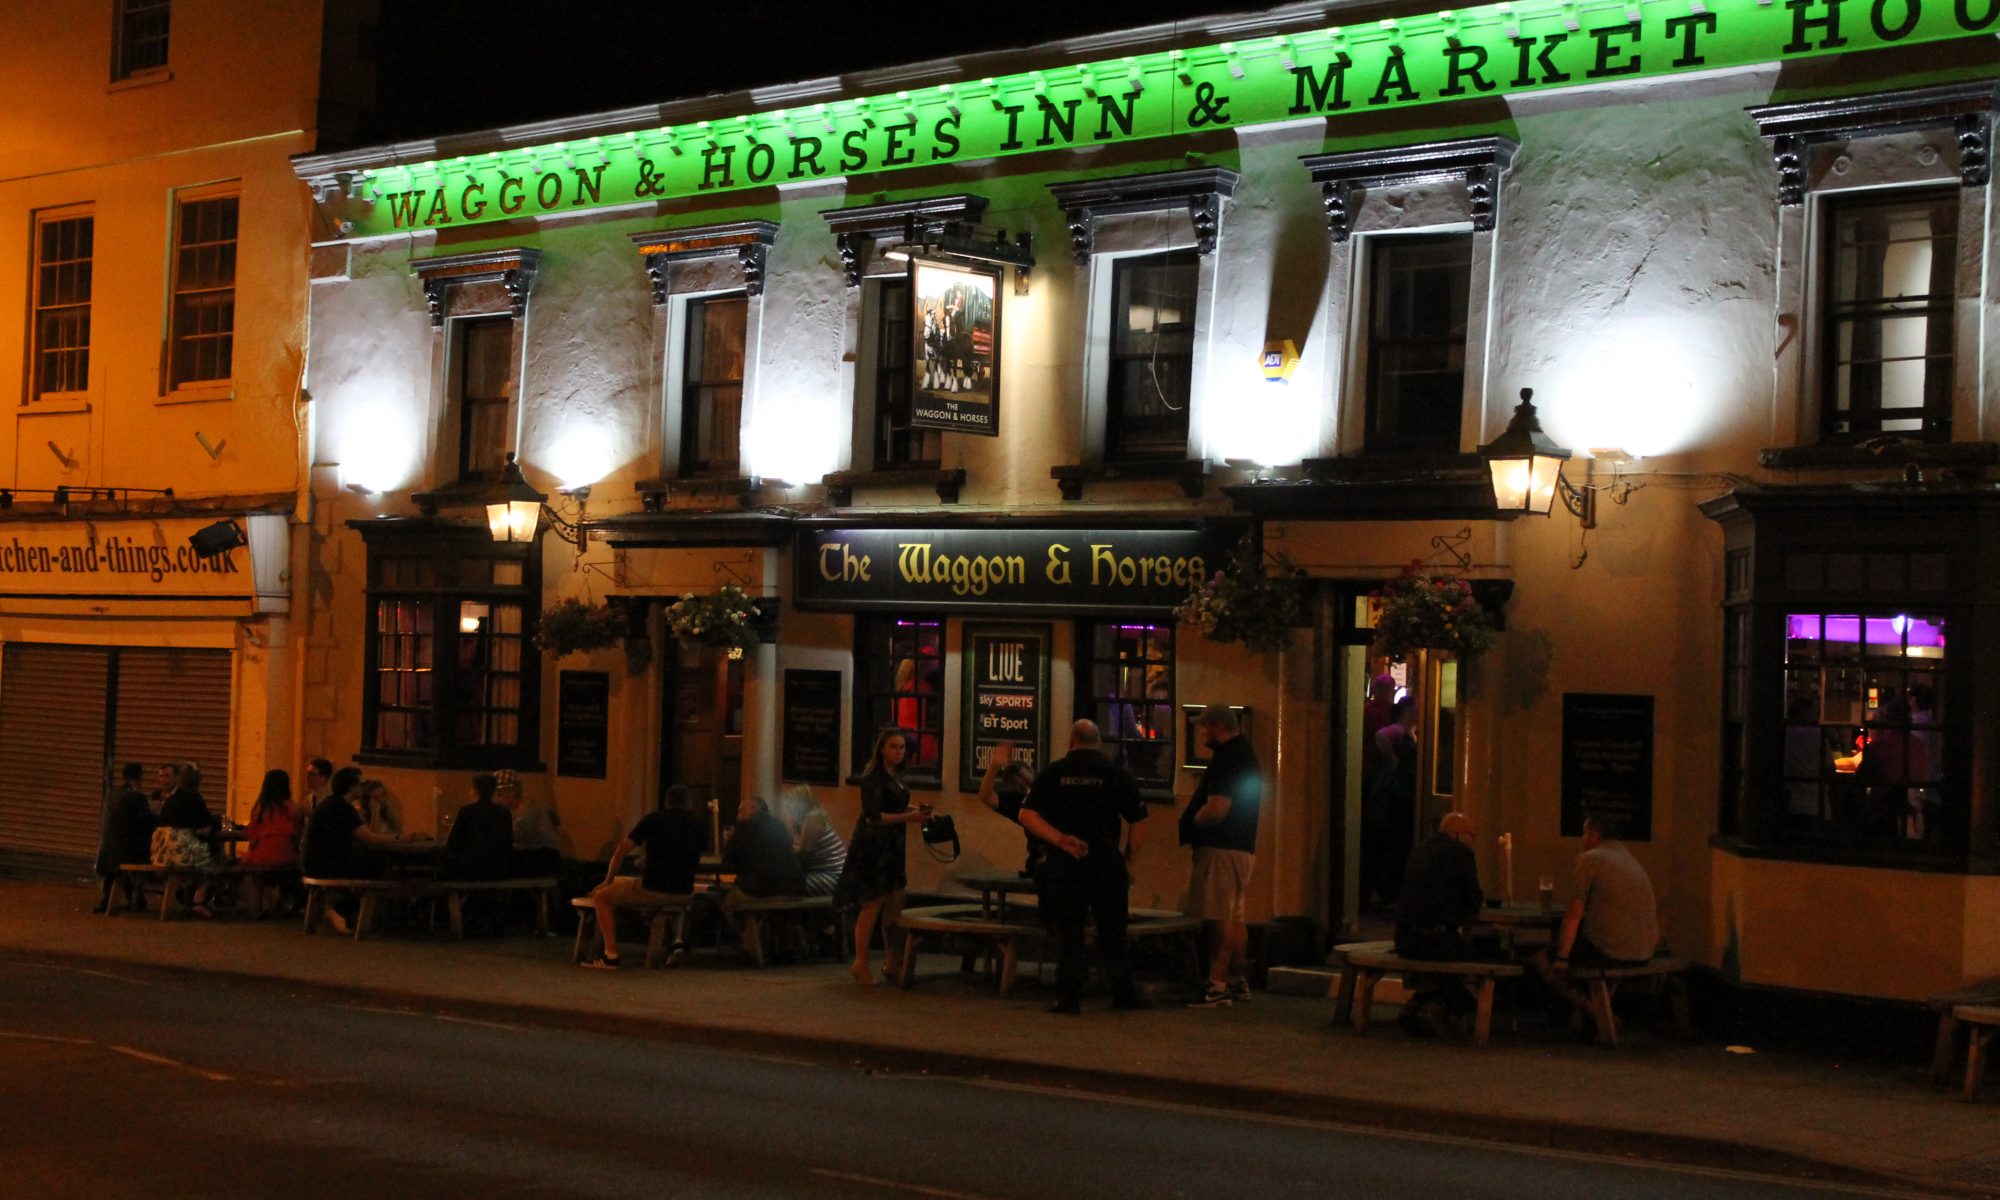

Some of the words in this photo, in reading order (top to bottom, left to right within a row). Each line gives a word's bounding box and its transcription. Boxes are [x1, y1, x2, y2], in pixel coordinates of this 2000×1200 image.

[386, 165, 606, 228] WAGGON
[634, 159, 665, 198] &
[698, 115, 961, 190] HORSES
[1000, 92, 1144, 150] INN
[1187, 82, 1231, 128] &
[1288, 12, 1717, 115] MARKET
[946, 402, 958, 411] THE
[915, 408, 951, 420] WAGGON
[953, 412, 958, 421] &
[960, 413, 988, 424] HORSES
[819, 543, 872, 583] The
[898, 543, 1025, 596] Waggon
[1045, 543, 1072, 584] &
[1090, 544, 1206, 587] Horses
[989, 643, 1024, 682] LIVE
[979, 695, 993, 707] sky
[995, 696, 1033, 708] SPORTS
[984, 717, 999, 728] BT
[1000, 716, 1028, 730] Sport
[1060, 776, 1104, 787] SECURITY
